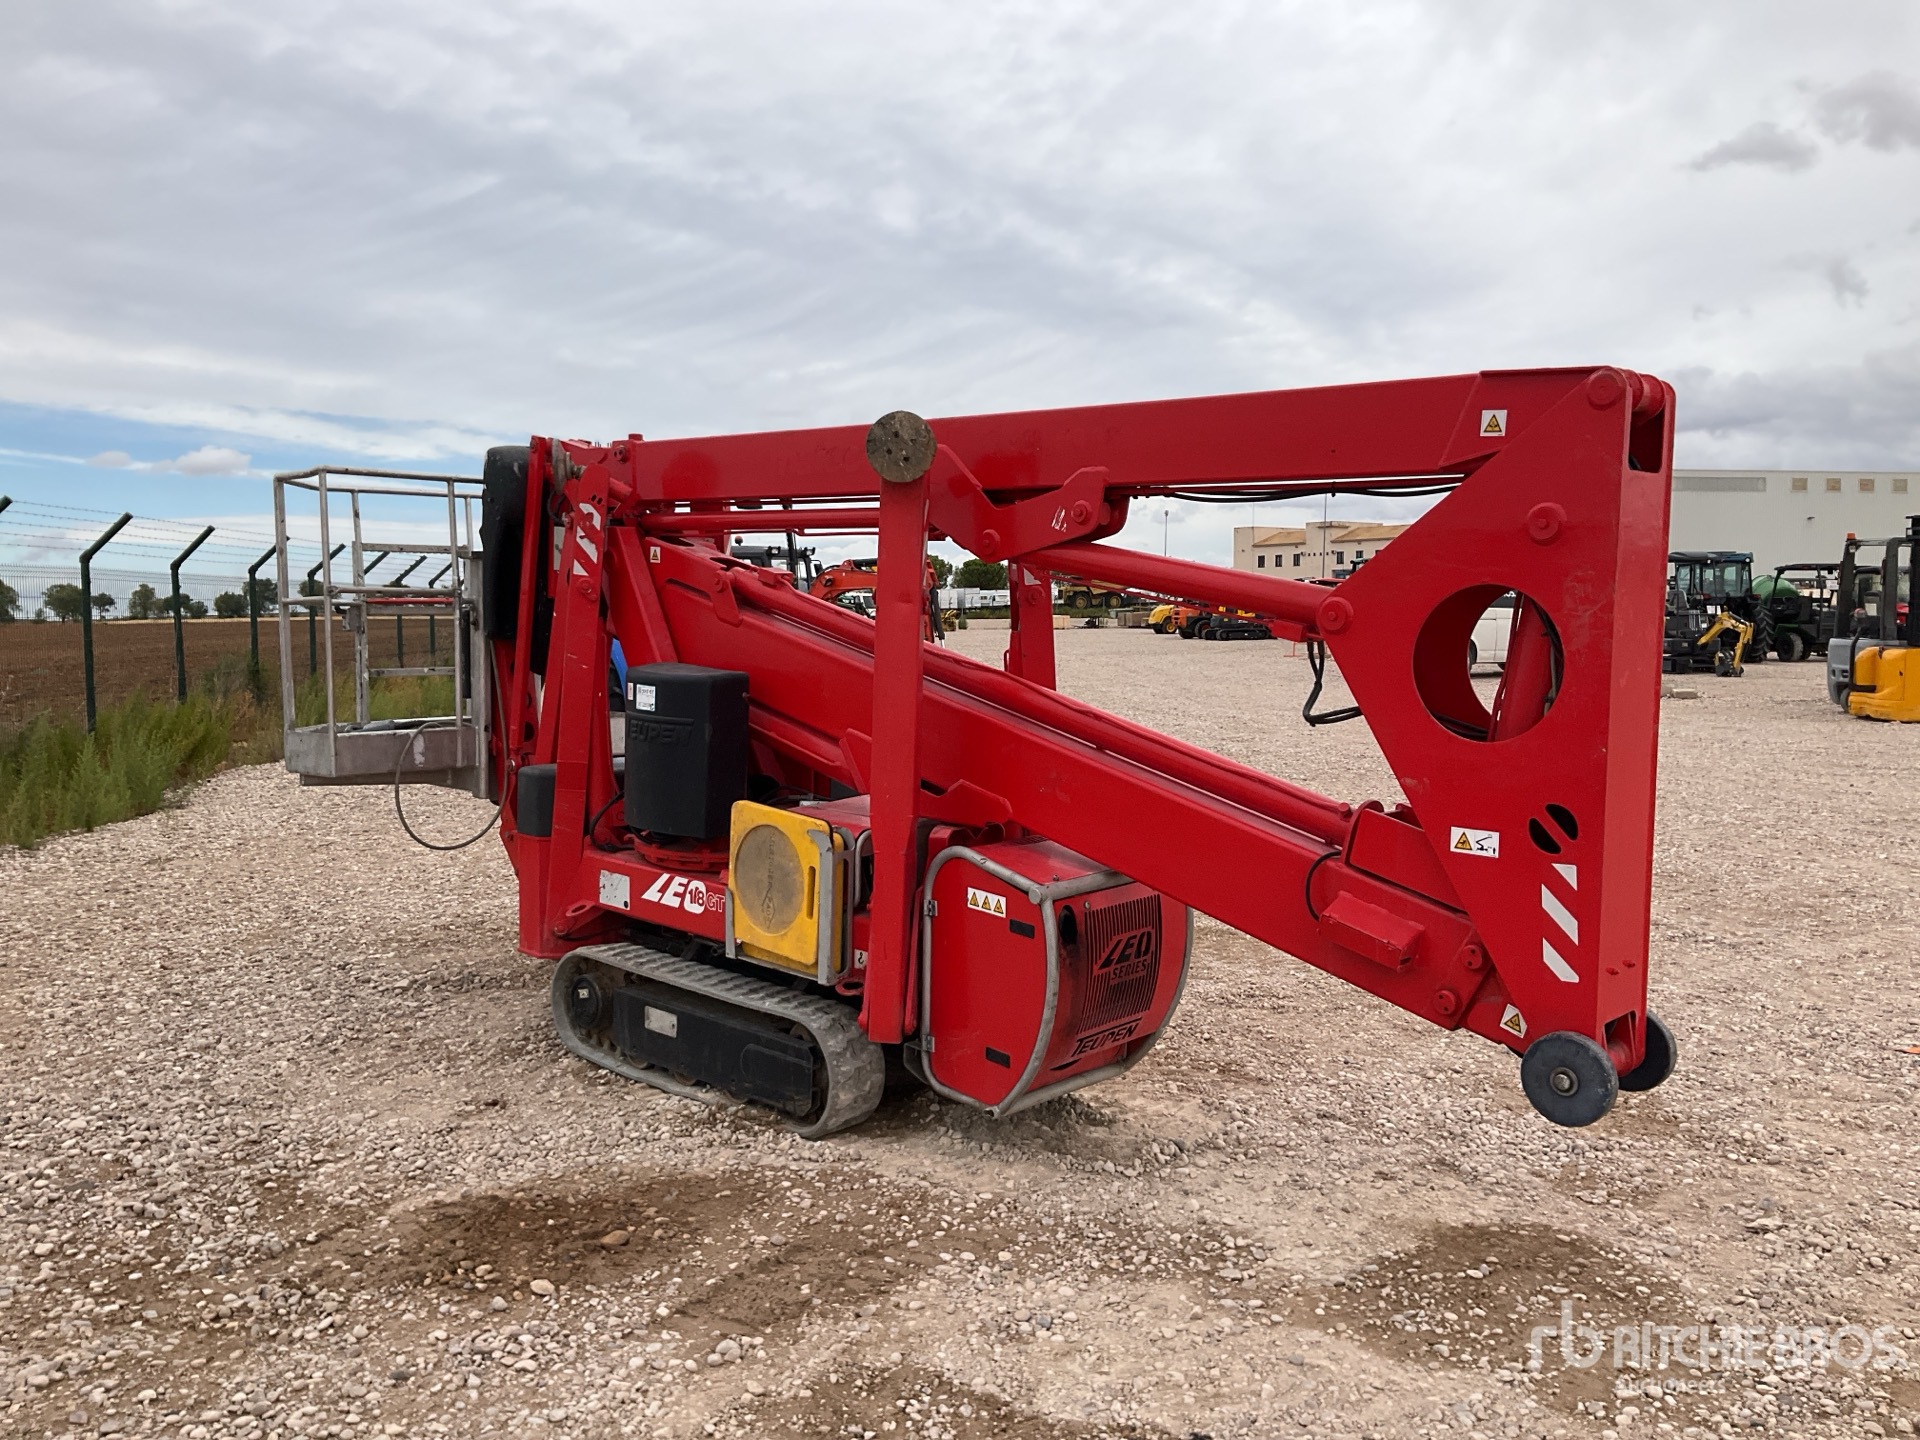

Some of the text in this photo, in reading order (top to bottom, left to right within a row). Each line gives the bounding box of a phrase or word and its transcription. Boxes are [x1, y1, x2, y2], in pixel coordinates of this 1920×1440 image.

[641, 873, 707, 914] LEO
[1098, 931, 1152, 970] LEO
[1110, 959, 1148, 981] SERIES
[1071, 1017, 1143, 1058] TEUPEN
